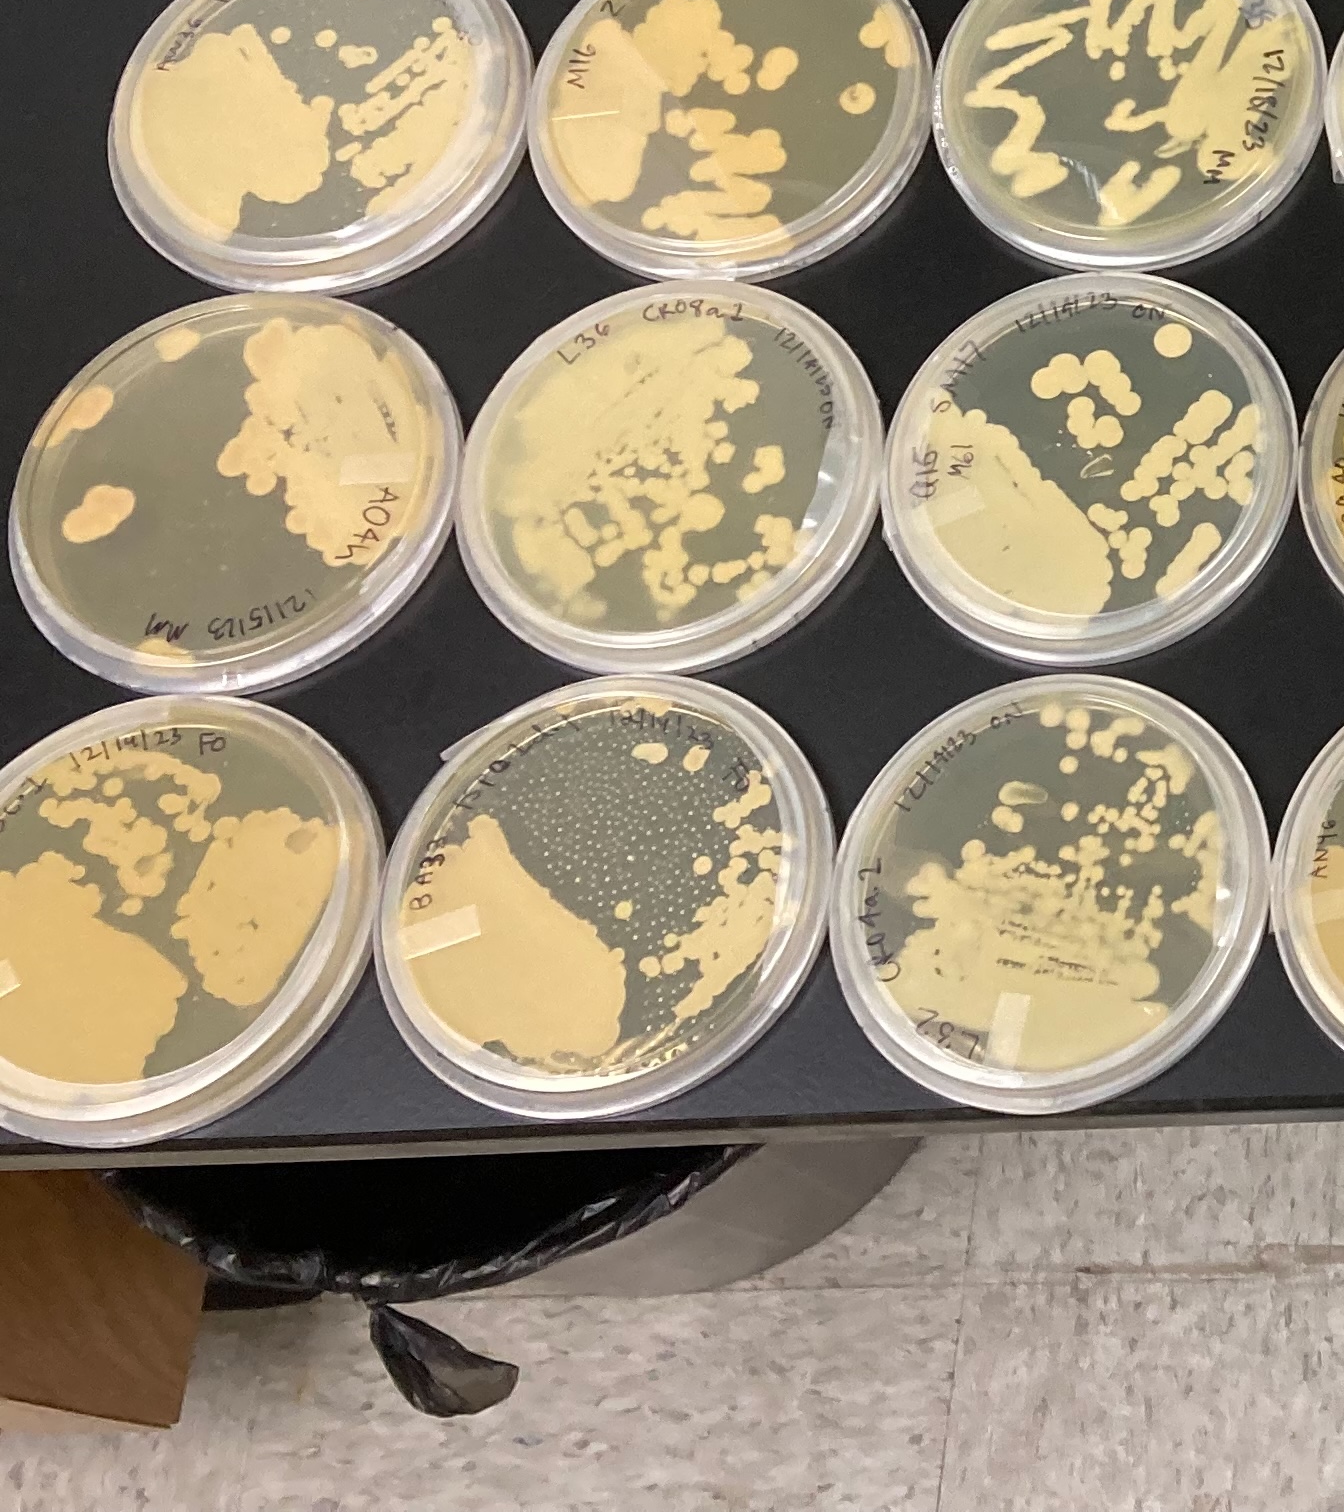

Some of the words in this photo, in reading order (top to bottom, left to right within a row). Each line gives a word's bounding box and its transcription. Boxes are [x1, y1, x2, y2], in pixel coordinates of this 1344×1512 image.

[564, 40, 599, 88] M16
[139, 611, 188, 646] MM
[64, 726, 184, 771] 12/14/23
